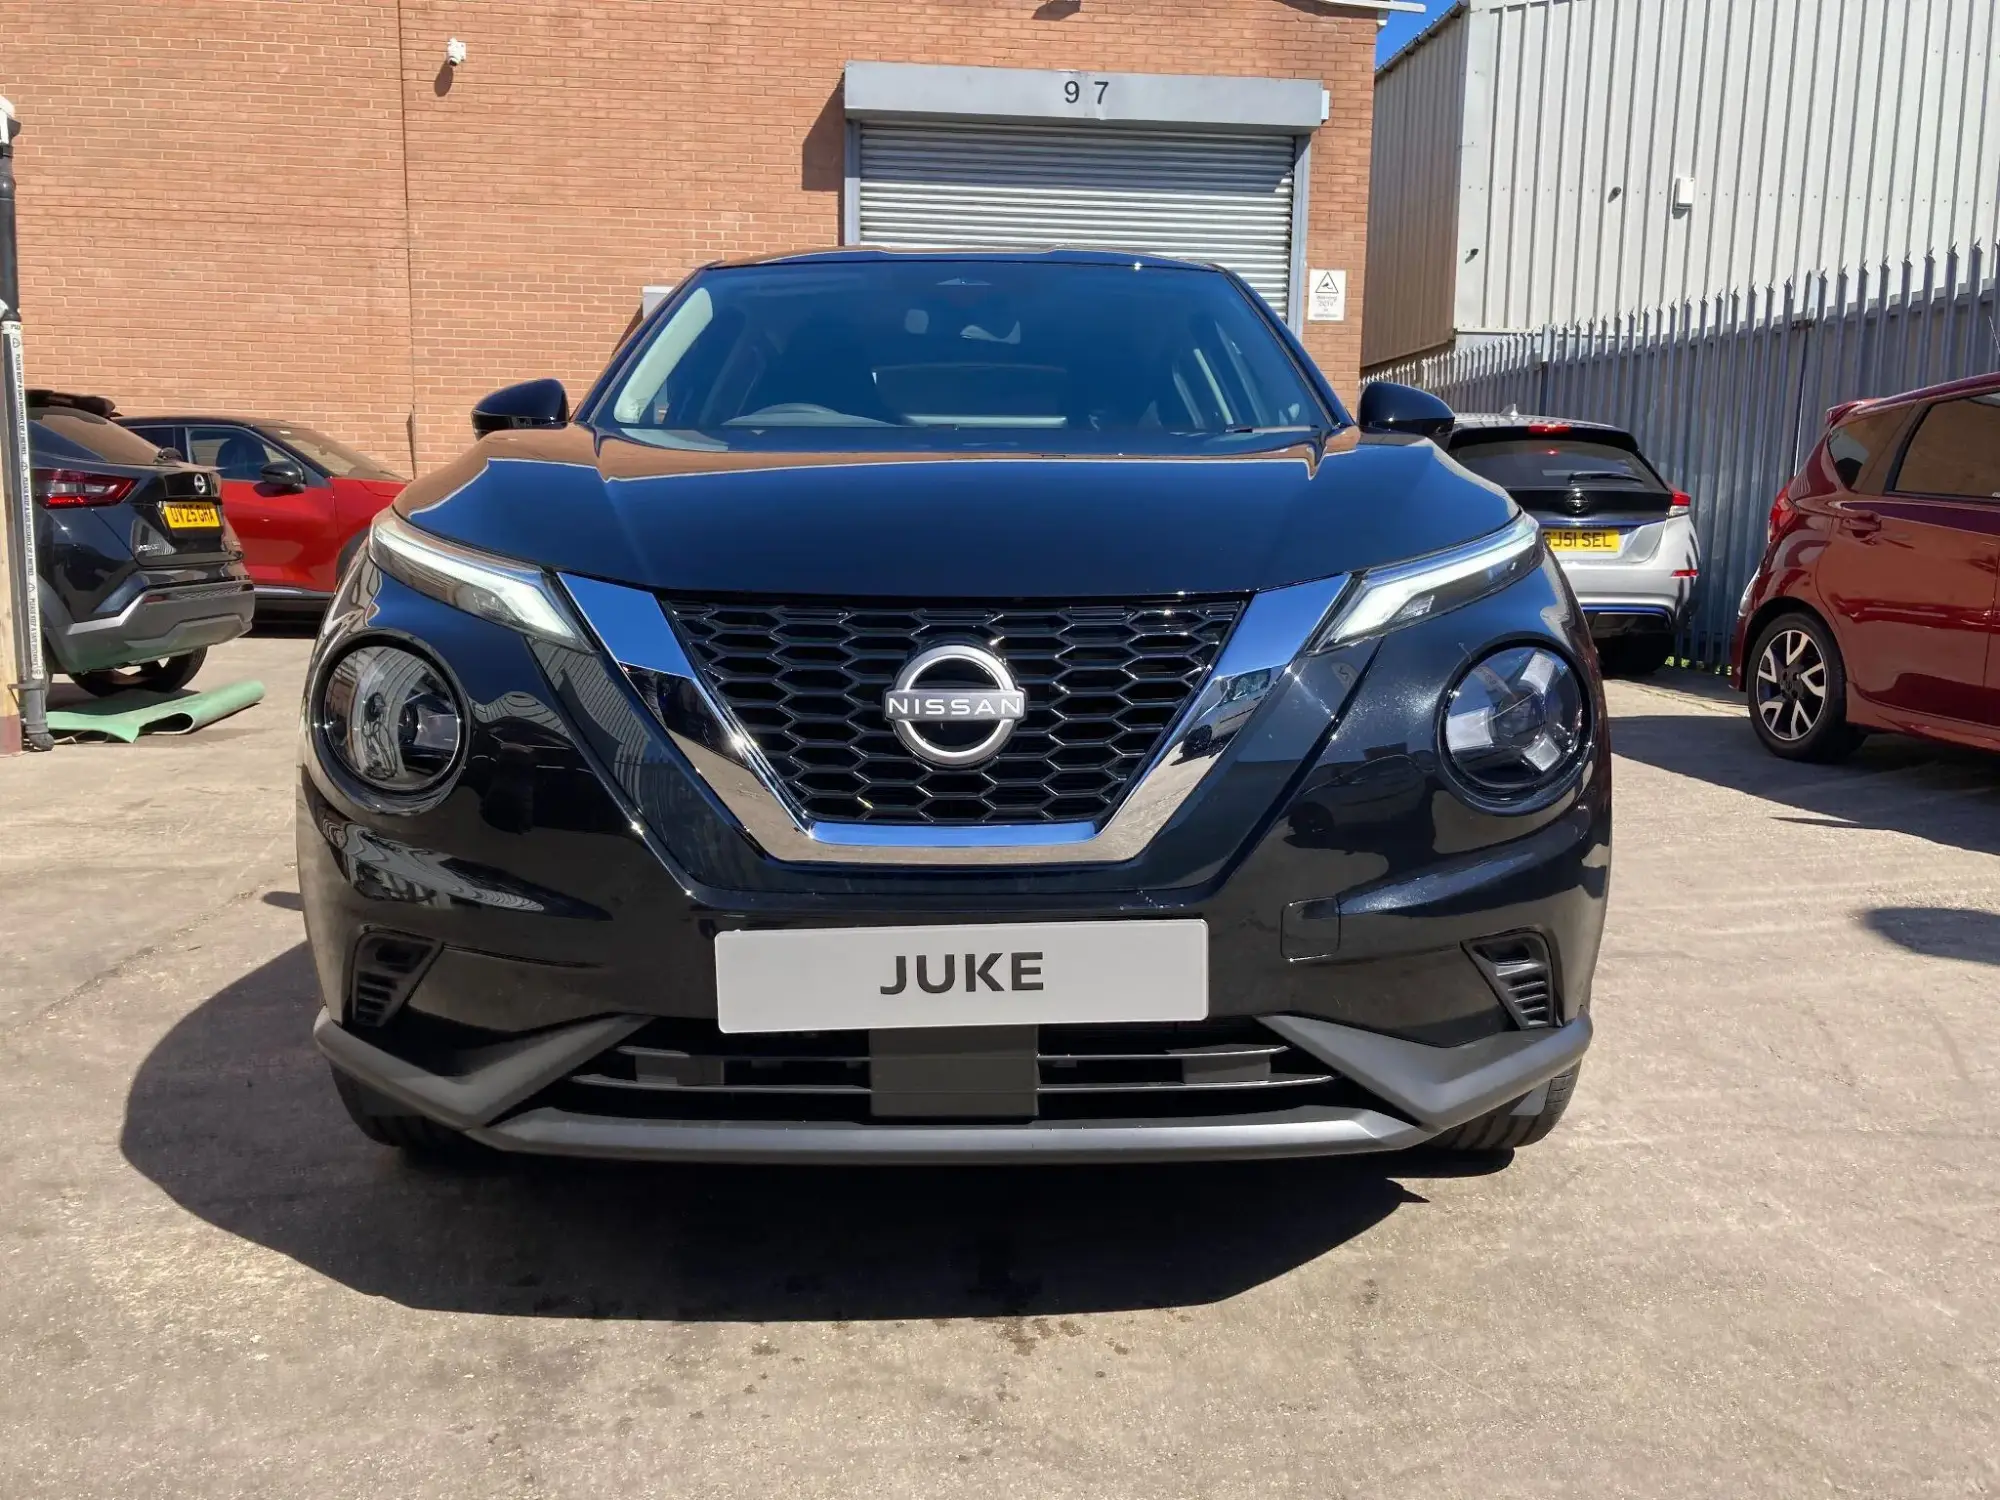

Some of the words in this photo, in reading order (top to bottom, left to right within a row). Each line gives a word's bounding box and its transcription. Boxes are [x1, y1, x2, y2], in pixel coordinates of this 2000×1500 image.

[1581, 531, 1612, 547] SEL
[888, 698, 1020, 715] NISSAN
[880, 952, 1044, 995] JUKE
